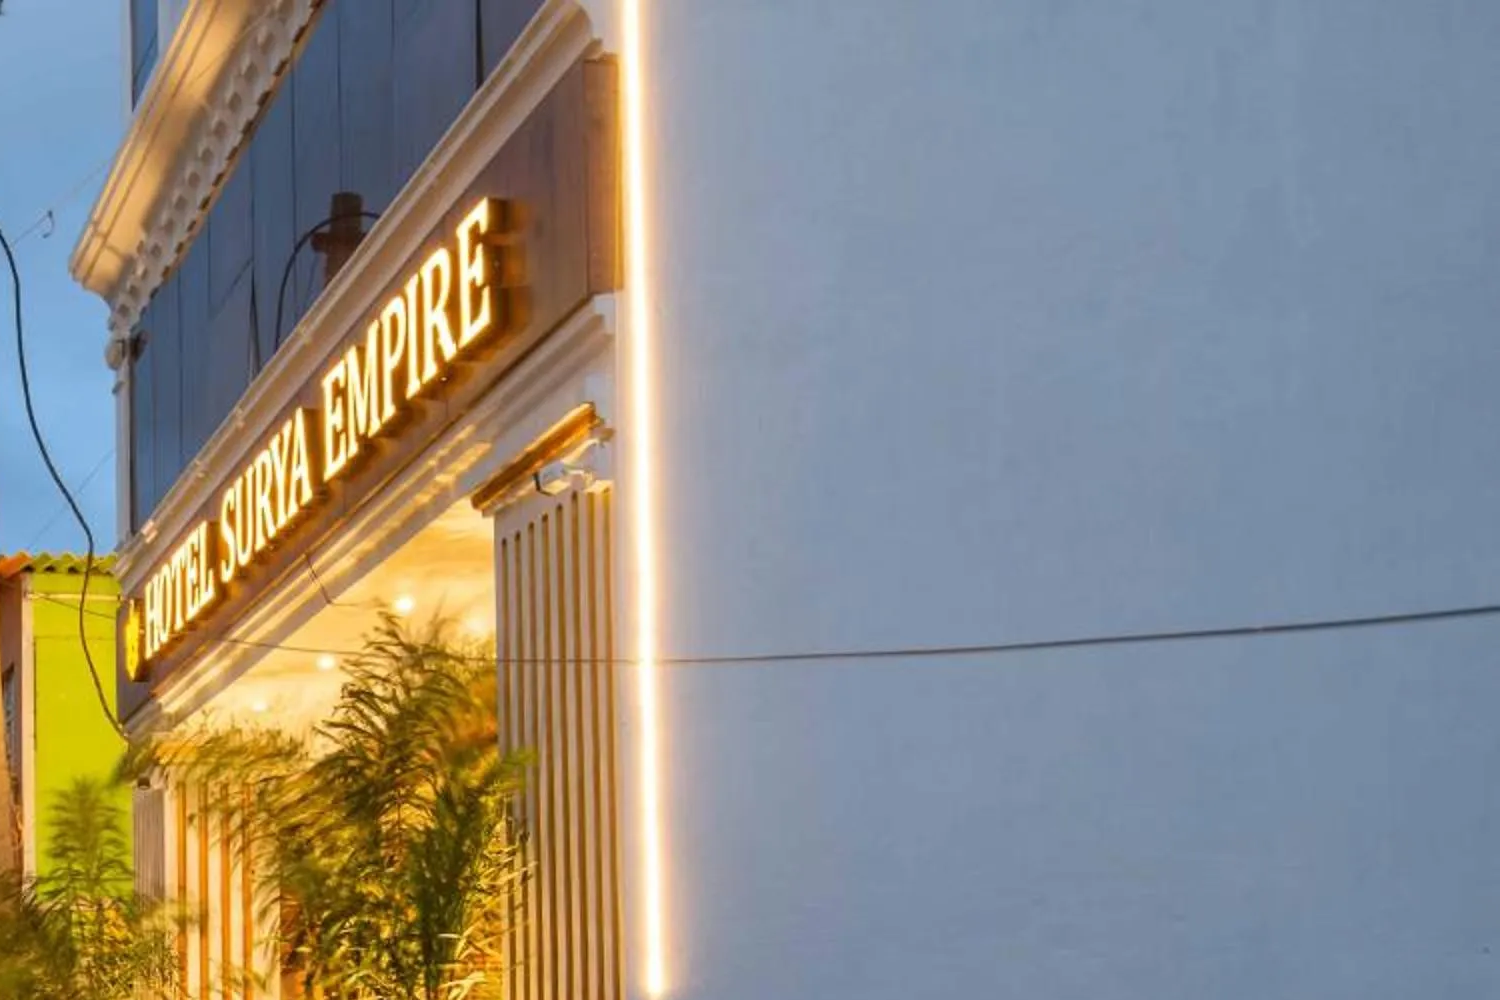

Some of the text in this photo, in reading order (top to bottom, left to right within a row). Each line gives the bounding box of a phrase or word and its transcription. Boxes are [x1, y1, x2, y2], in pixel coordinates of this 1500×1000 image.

[145, 196, 493, 661] HOTEL SURYA EMPIRE
